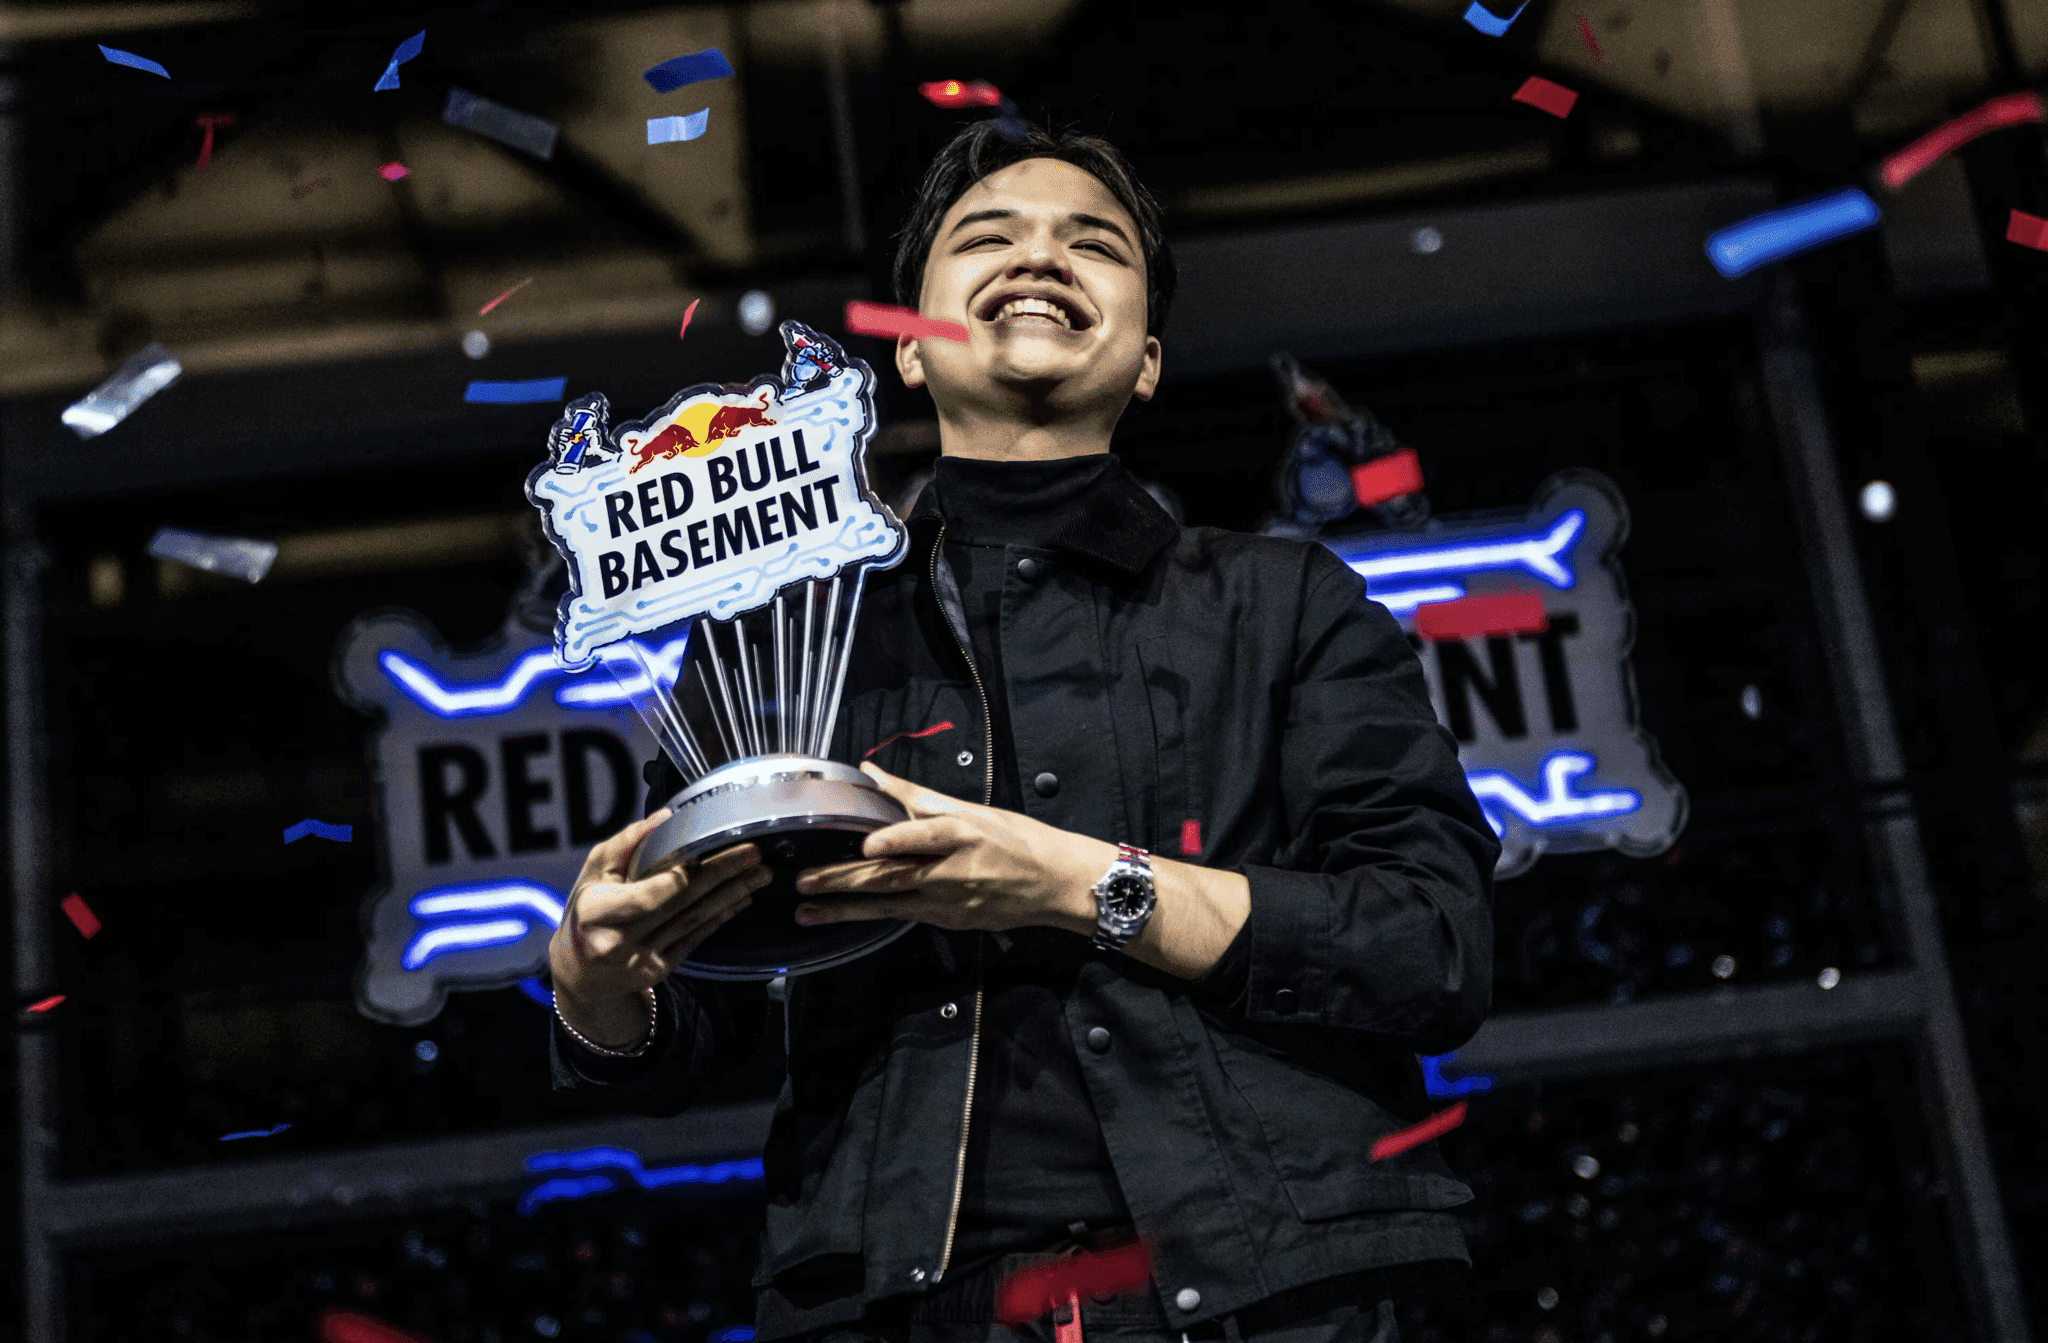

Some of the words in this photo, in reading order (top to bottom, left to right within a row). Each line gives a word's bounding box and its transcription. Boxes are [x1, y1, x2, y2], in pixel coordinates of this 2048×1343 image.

[598, 475, 840, 600] BASEMENT
[604, 472, 694, 539] RED
[707, 428, 820, 504] BULL
[1407, 612, 1578, 742] NT
[417, 725, 638, 867] RED
